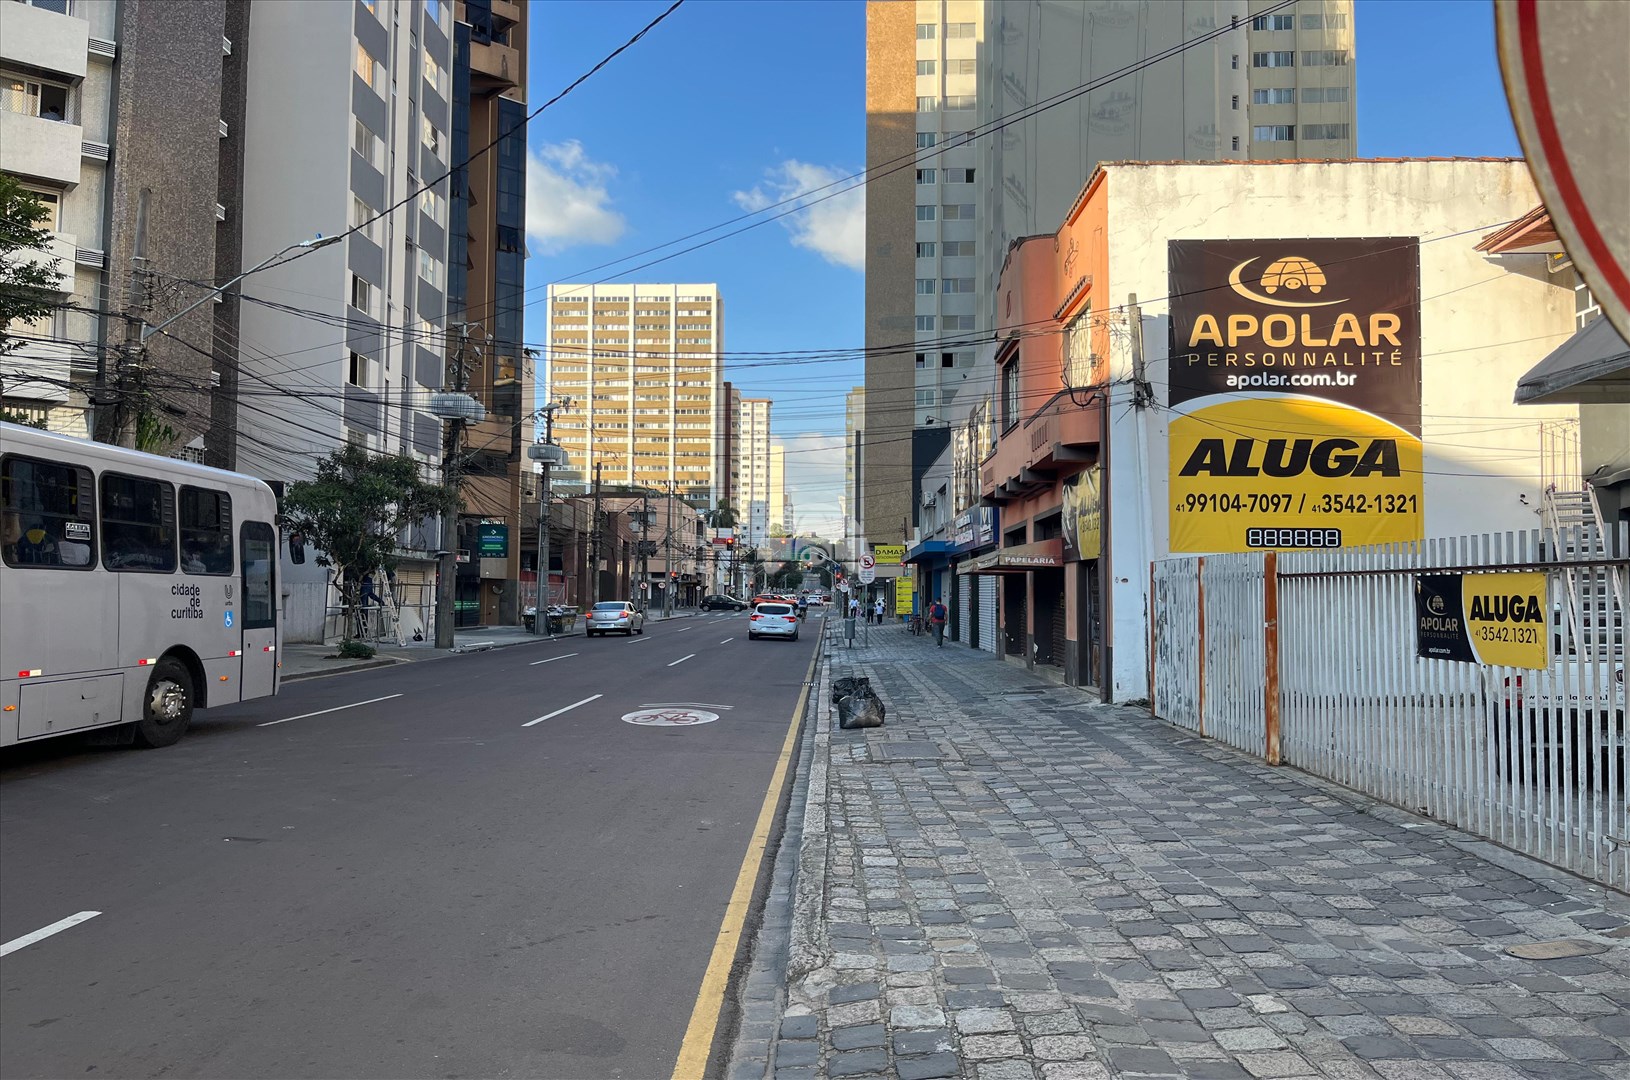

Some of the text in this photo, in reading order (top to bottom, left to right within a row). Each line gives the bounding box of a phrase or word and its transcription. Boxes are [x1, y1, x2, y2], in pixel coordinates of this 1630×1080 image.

[1188, 312, 1402, 348] APOLAR
[1188, 349, 1402, 367] PERSONNALITÉ
[1226, 371, 1357, 390] apolar.com.br
[1178, 438, 1400, 478] ALUGA
[1004, 556, 1055, 565] PAPELARIA
[171, 583, 200, 596] cidade
[190, 596, 200, 607] de
[1470, 595, 1543, 623] ALUGA
[171, 606, 203, 619] curitiba
[1420, 617, 1458, 632] APOLAR
